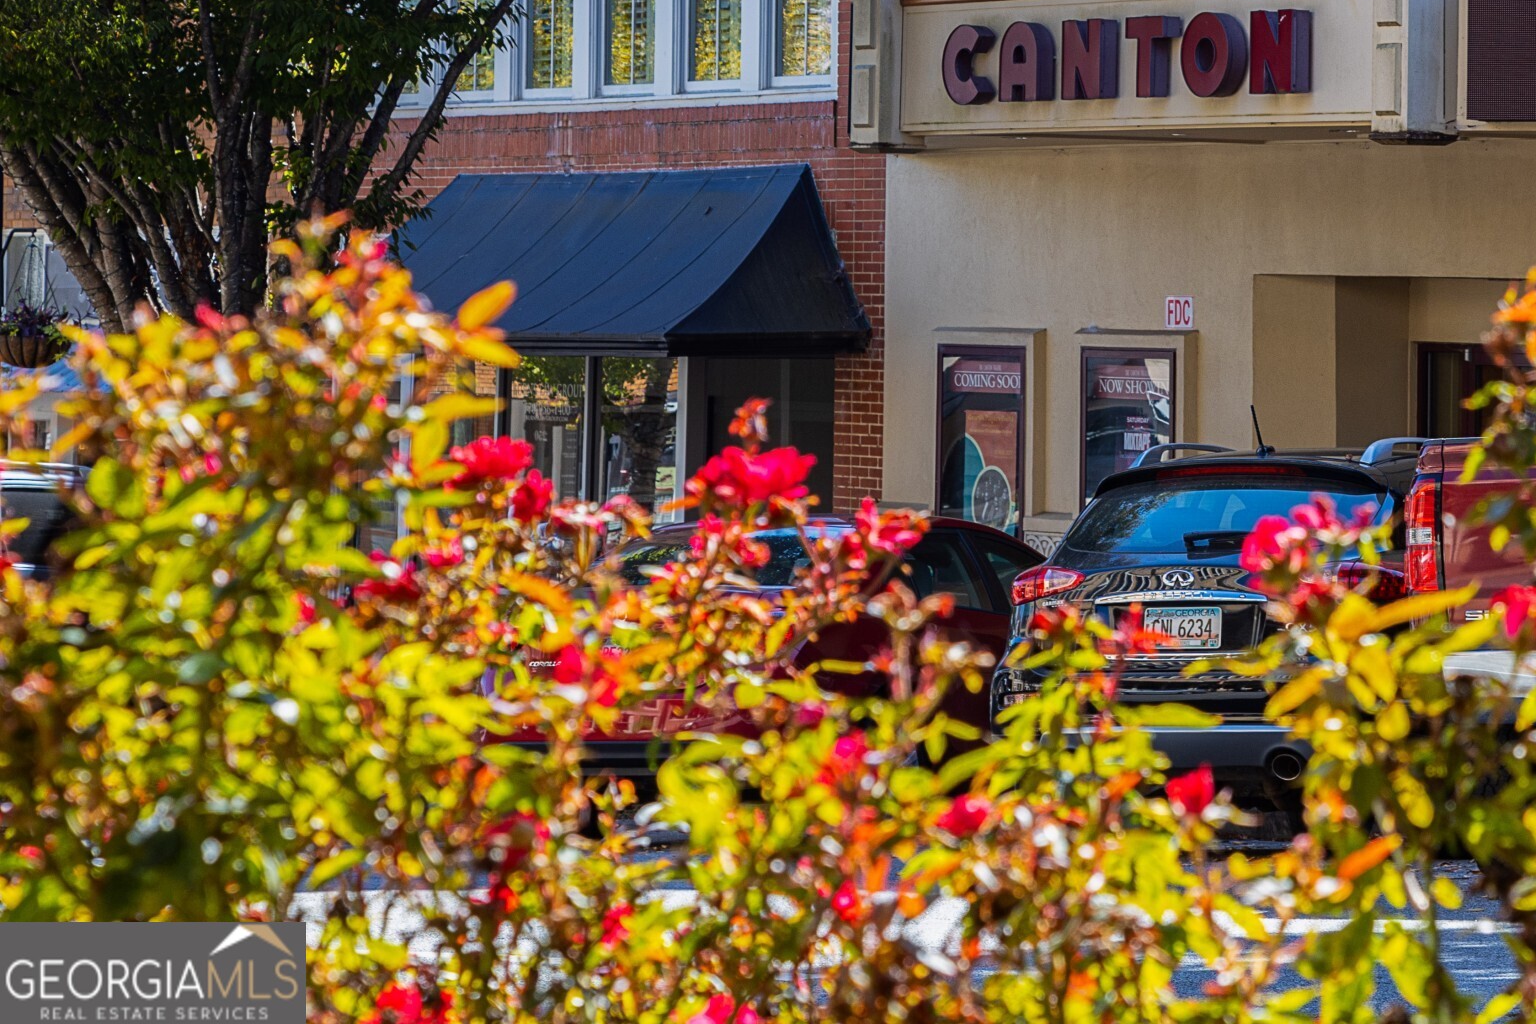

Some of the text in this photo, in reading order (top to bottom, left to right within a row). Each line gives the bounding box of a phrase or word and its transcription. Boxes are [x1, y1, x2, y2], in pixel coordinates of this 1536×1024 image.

[941, 9, 1312, 106] CANTON
[1167, 296, 1191, 326] FDC
[954, 373, 1020, 389] COMING SOO
[1099, 379, 1169, 395] NOW SHOWIN
[1174, 608, 1216, 617] GEORGIA
